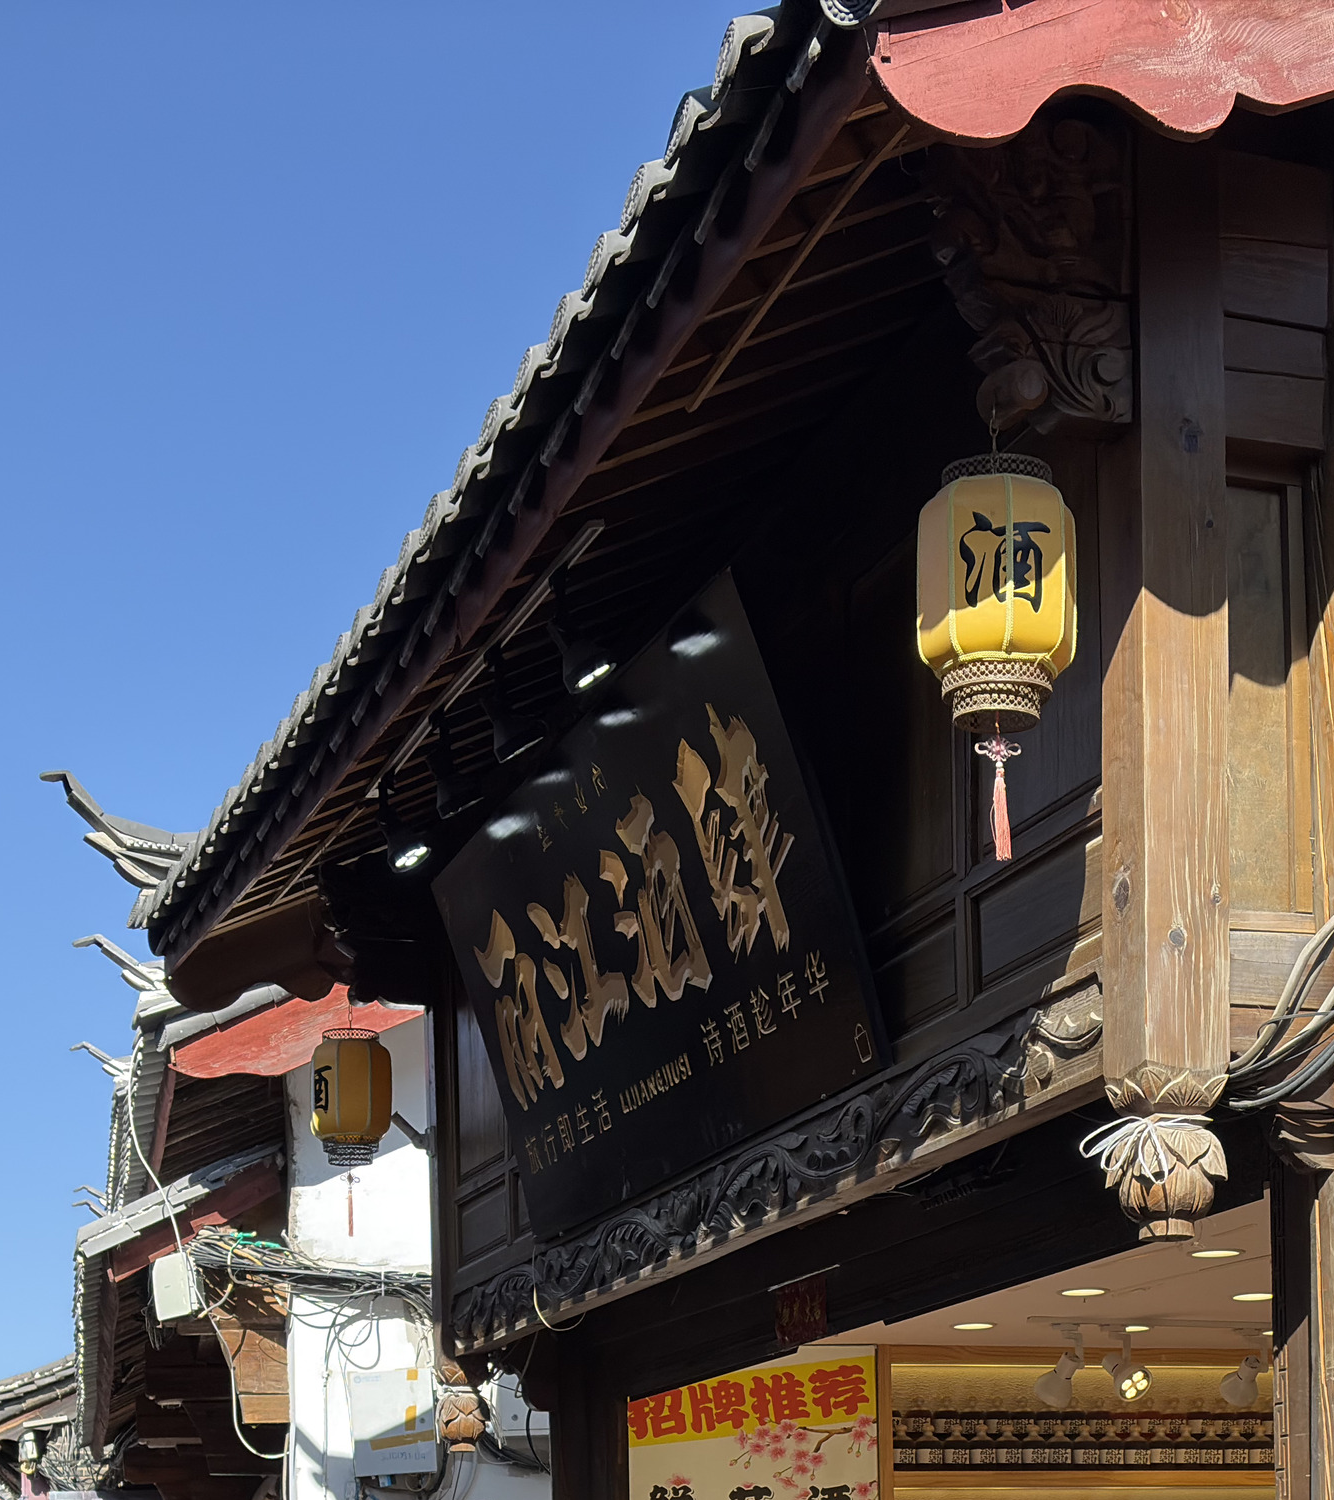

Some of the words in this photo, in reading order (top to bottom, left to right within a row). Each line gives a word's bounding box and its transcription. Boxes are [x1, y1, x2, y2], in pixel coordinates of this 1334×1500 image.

[959, 511, 1051, 613] 酒
[700, 948, 830, 1067] 诗酒趁年华
[620, 1052, 693, 1114] LIJIANGJIUSI
[523, 1087, 615, 1175] 旅行即生活
[628, 1364, 870, 1440] 招牌推荐
